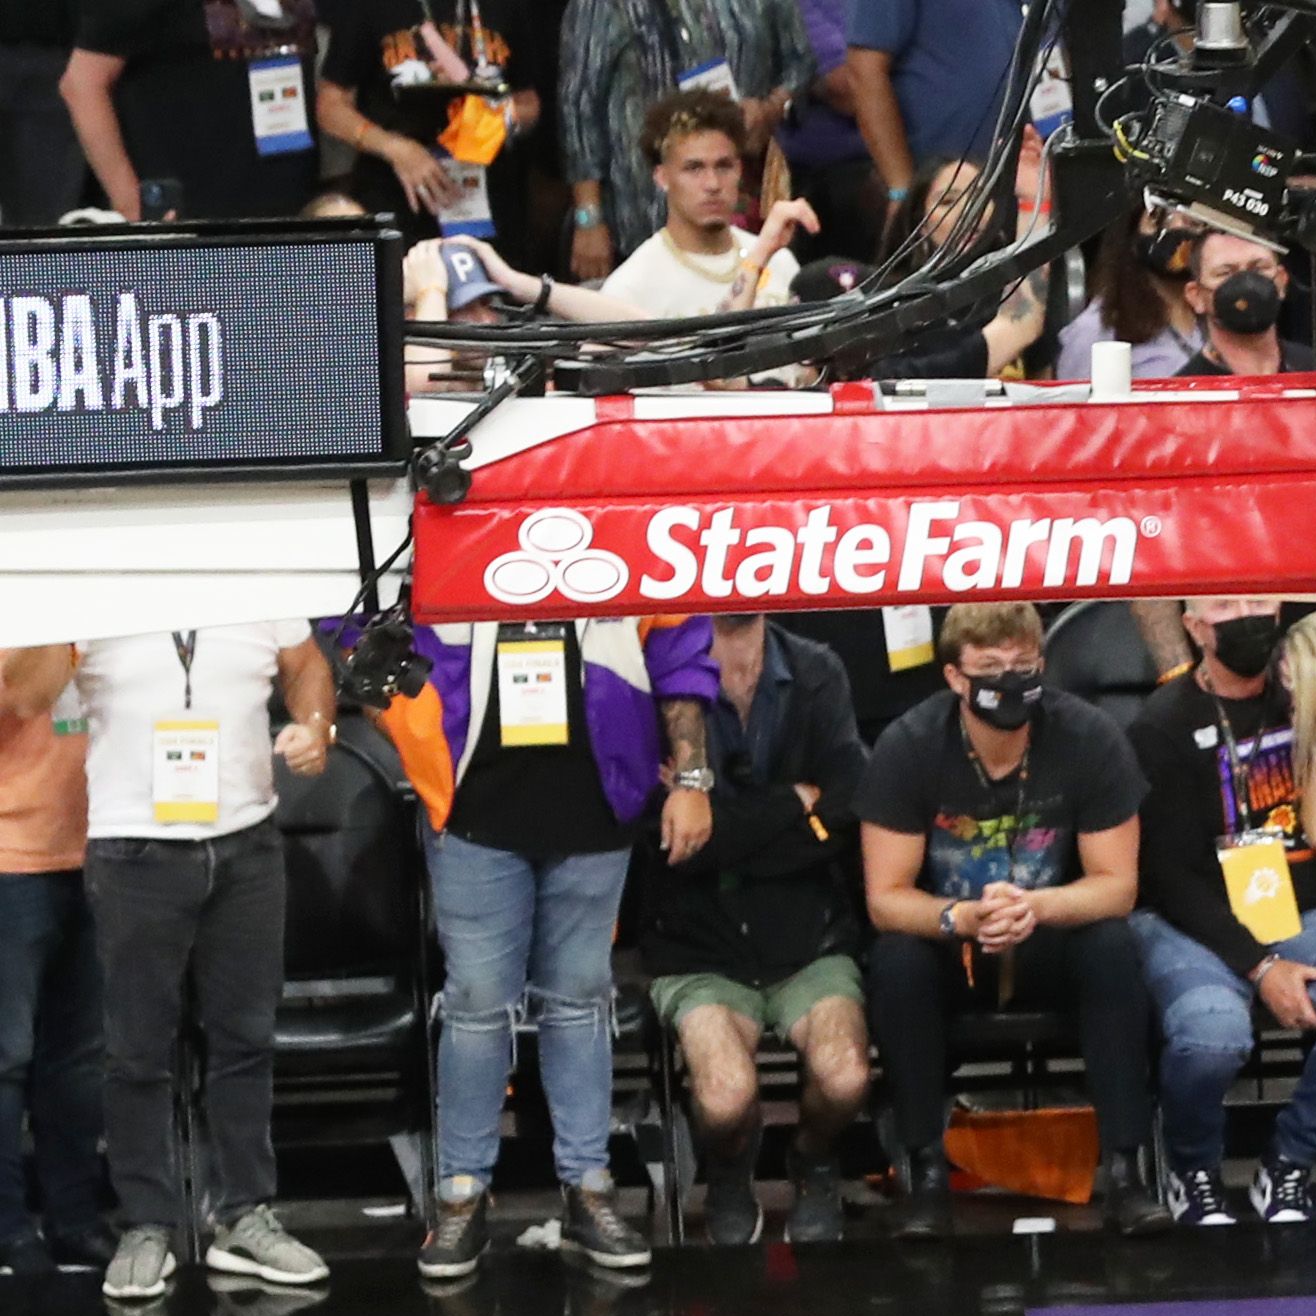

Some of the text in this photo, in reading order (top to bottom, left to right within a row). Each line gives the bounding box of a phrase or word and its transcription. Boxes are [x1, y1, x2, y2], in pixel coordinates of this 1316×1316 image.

[451, 251, 474, 283] P
[0, 292, 224, 431] BA App
